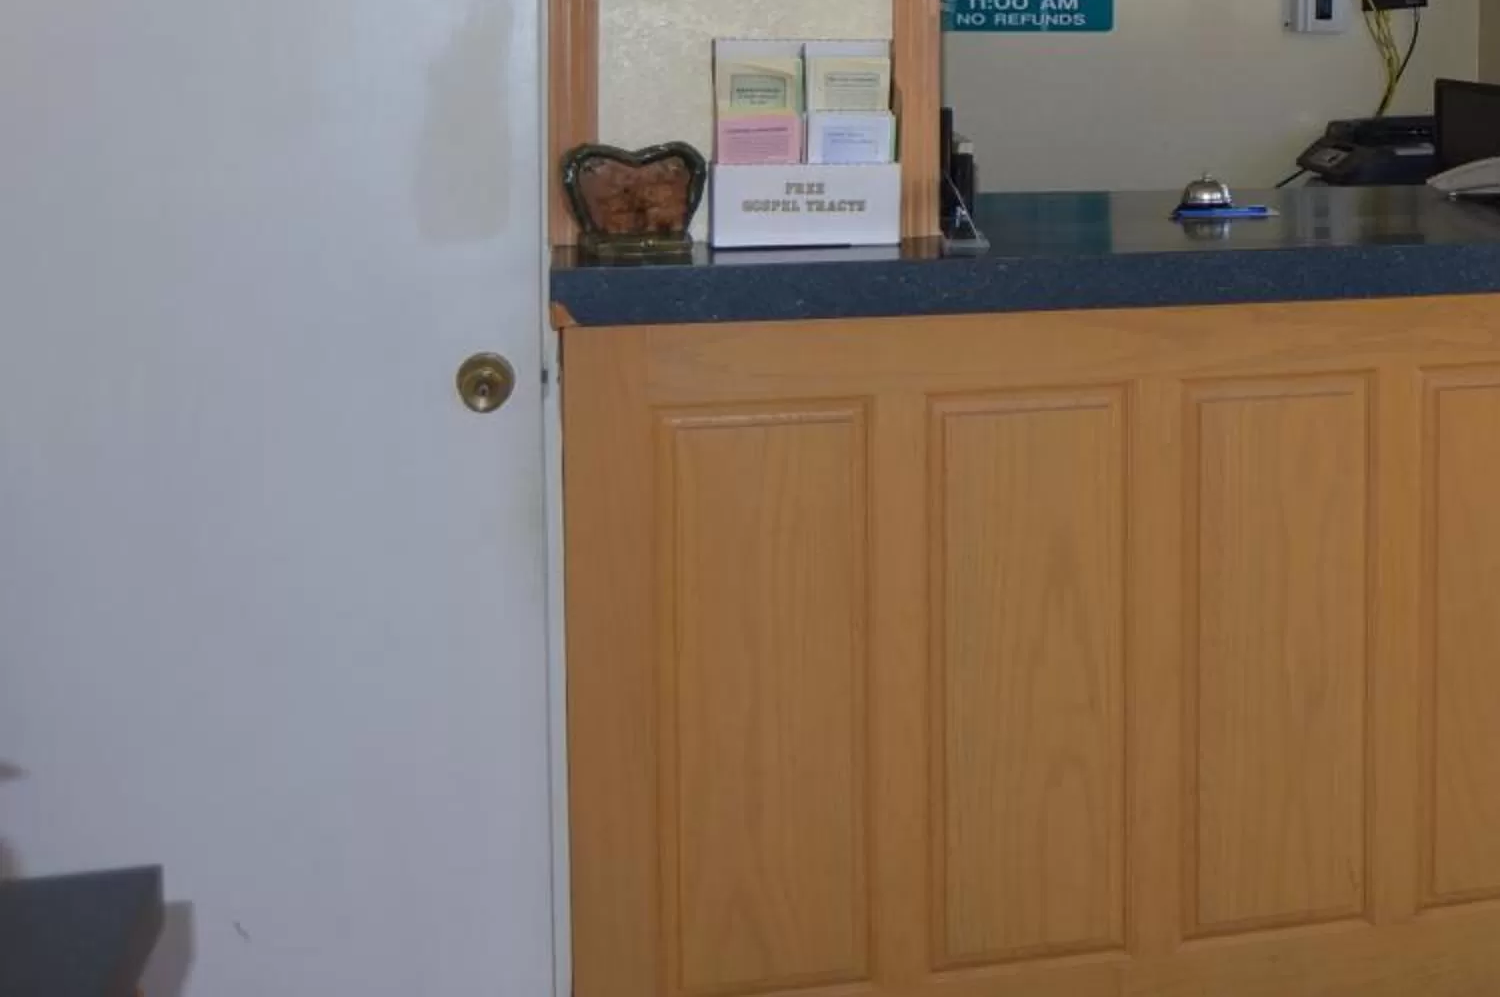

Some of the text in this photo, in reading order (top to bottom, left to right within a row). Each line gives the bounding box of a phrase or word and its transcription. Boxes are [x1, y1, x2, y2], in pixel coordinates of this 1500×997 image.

[956, 13, 1087, 27] NO REFUNDS
[785, 181, 826, 195] FREE
[741, 199, 868, 213] GOSPEL TRACTS
